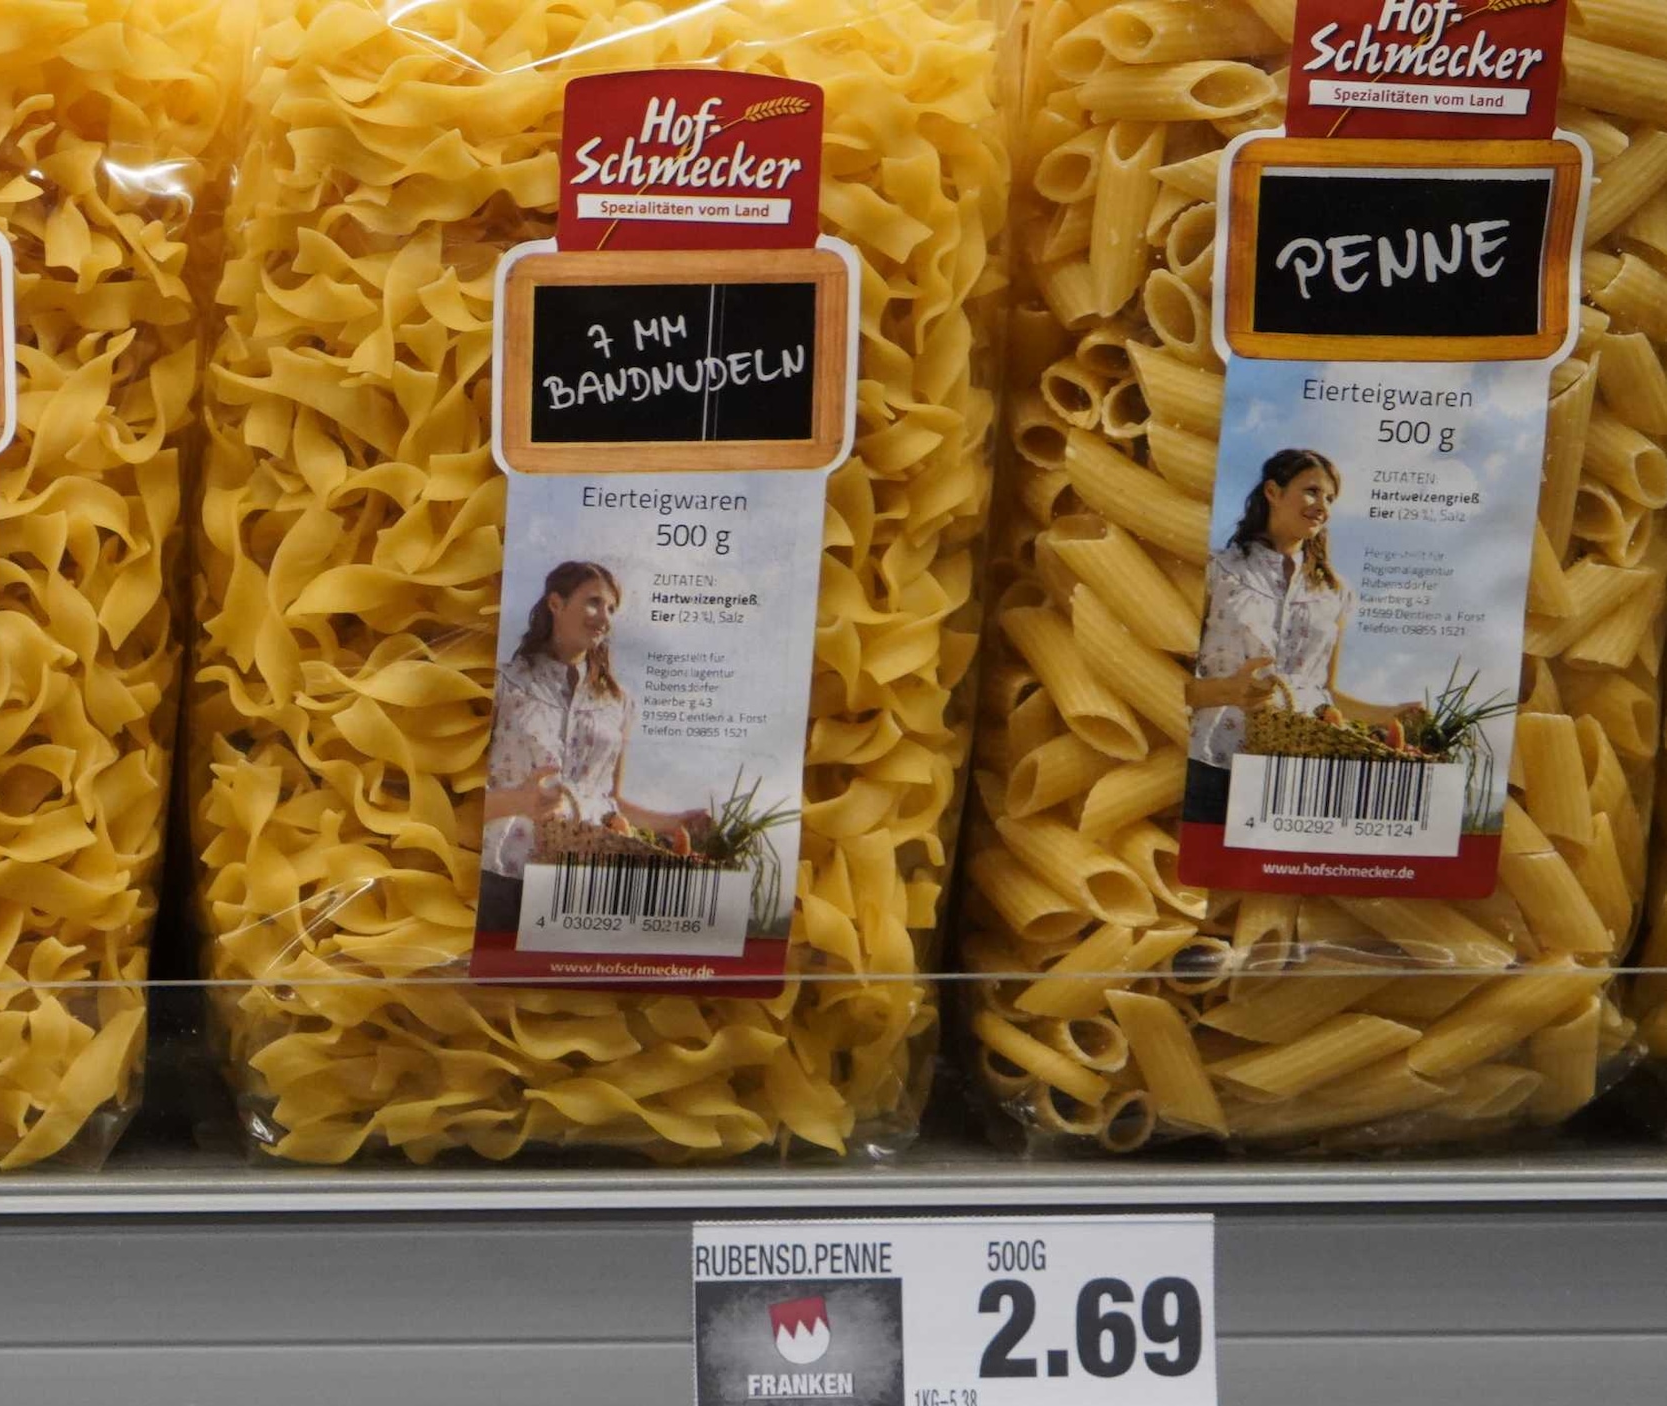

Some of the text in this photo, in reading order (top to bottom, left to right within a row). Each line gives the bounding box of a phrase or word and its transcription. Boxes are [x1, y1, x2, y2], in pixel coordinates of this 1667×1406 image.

[1303, 22, 1542, 81] Schmecker
[1334, 87, 1504, 108] Spezialitäten vom Land
[640, 96, 722, 160] Hof-
[570, 137, 802, 189] Schmecker
[1276, 219, 1510, 300] PENNE
[587, 315, 688, 359] 7 MM
[543, 344, 805, 410] BANDNUDELN
[1303, 379, 1473, 411] Eierteigwaren
[1378, 420, 1455, 452] 500 g
[583, 486, 747, 515] Eierteigwaren
[1245, 817, 1413, 837] 4 030292 502124
[1263, 862, 1415, 879] www.hofschmecker.de
[695, 1241, 1046, 1276] RUBENSD.PENNE 500G
[977, 1276, 1202, 1379] 2.69
[748, 1373, 853, 1396] FRANKEN
